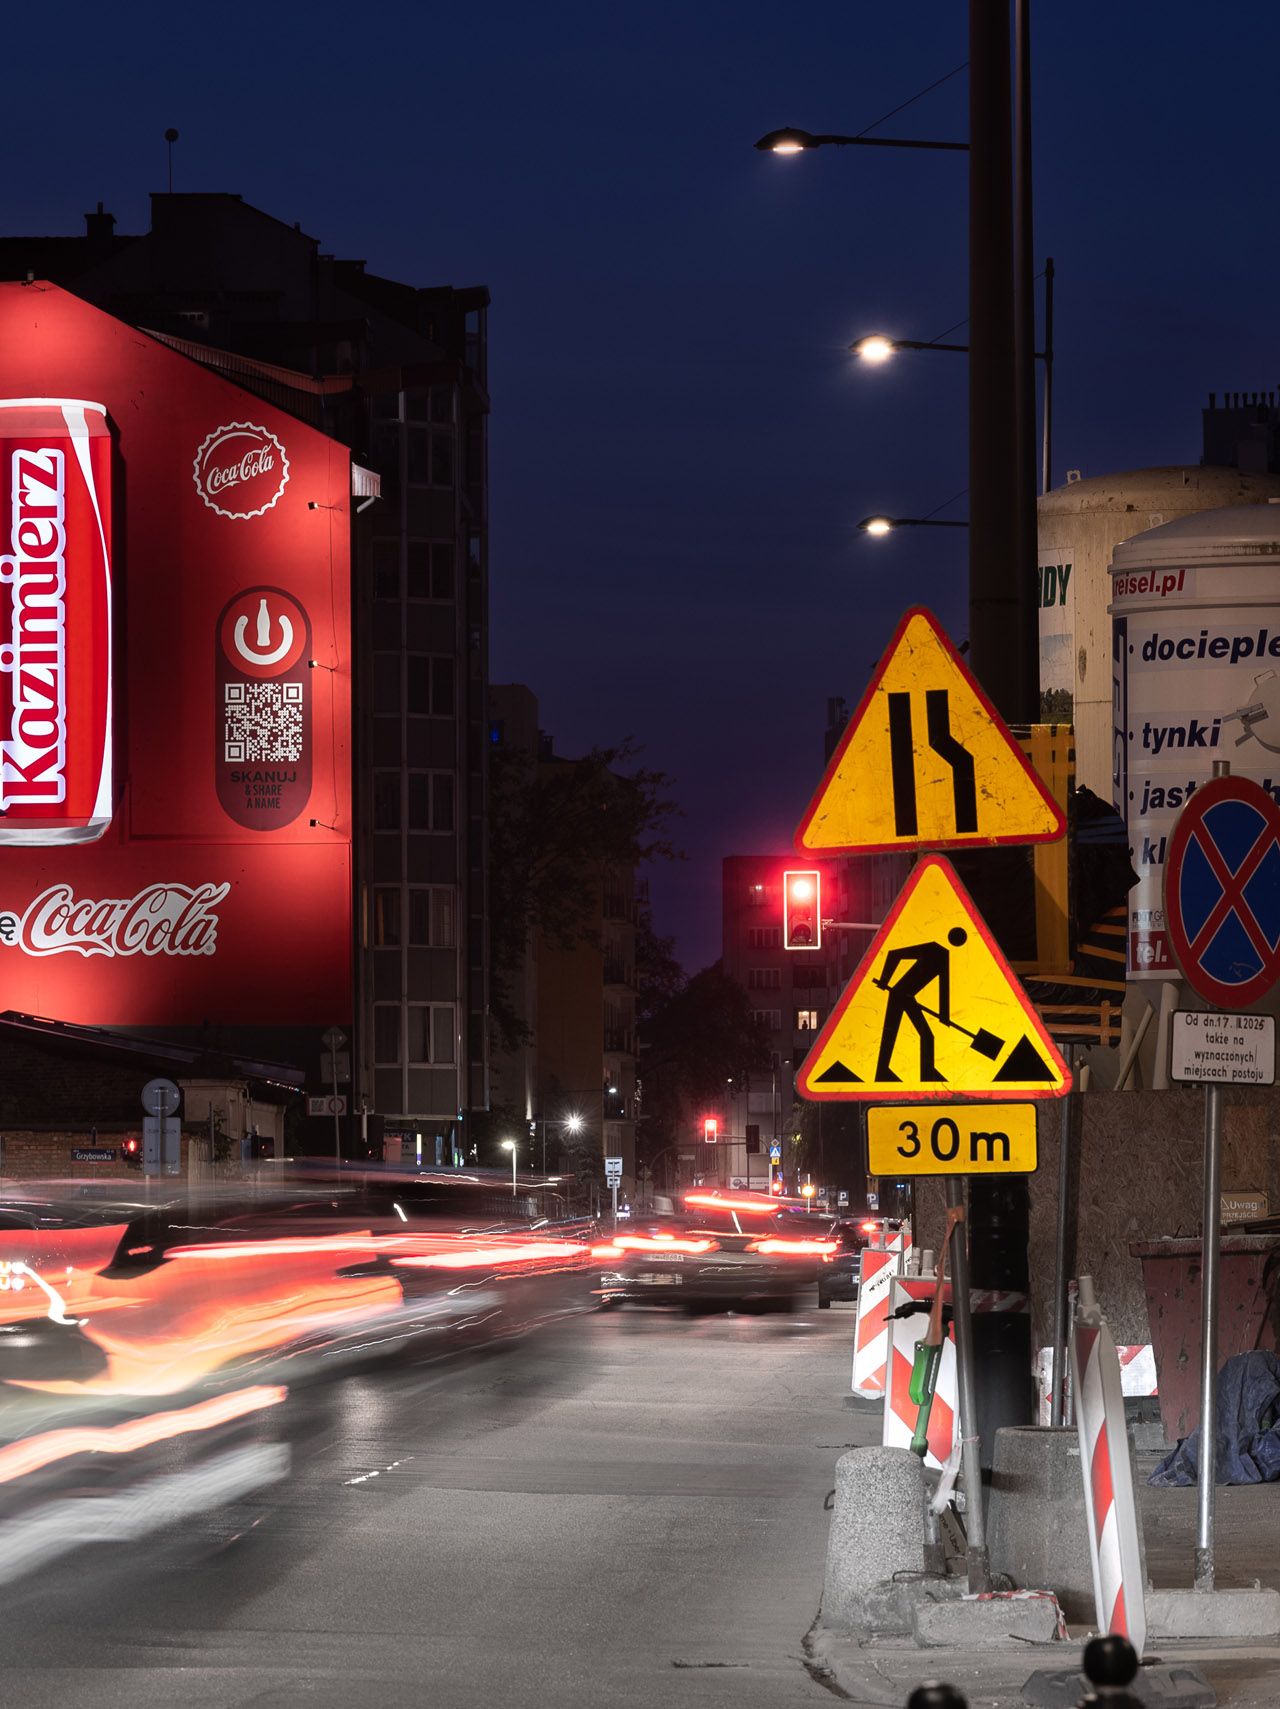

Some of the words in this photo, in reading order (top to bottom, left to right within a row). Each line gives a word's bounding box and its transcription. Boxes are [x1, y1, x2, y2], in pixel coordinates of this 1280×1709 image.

[207, 442, 275, 495] Coca-Cola
[1113, 569, 1185, 597] reisel.pl
[1142, 719, 1221, 754] tynki
[231, 771, 297, 783] SKANUJ
[253, 784, 282, 797] SHARE
[247, 799, 253, 809] A
[255, 798, 281, 809] NAME
[1141, 837, 1167, 865] kl
[22, 885, 229, 957] Coca-Cola
[1135, 940, 1168, 964] tel.
[1185, 1014, 1199, 1026] Od
[1205, 1032, 1229, 1045] także
[1233, 1036, 1244, 1046] na
[1194, 1050, 1254, 1066] wyznaczonych
[1184, 1064, 1227, 1079] miejscach
[1232, 1067, 1264, 1082] postoju
[897, 1117, 960, 1161] 30
[970, 1132, 1010, 1161] m
[75, 1152, 112, 1162] Grzybowska
